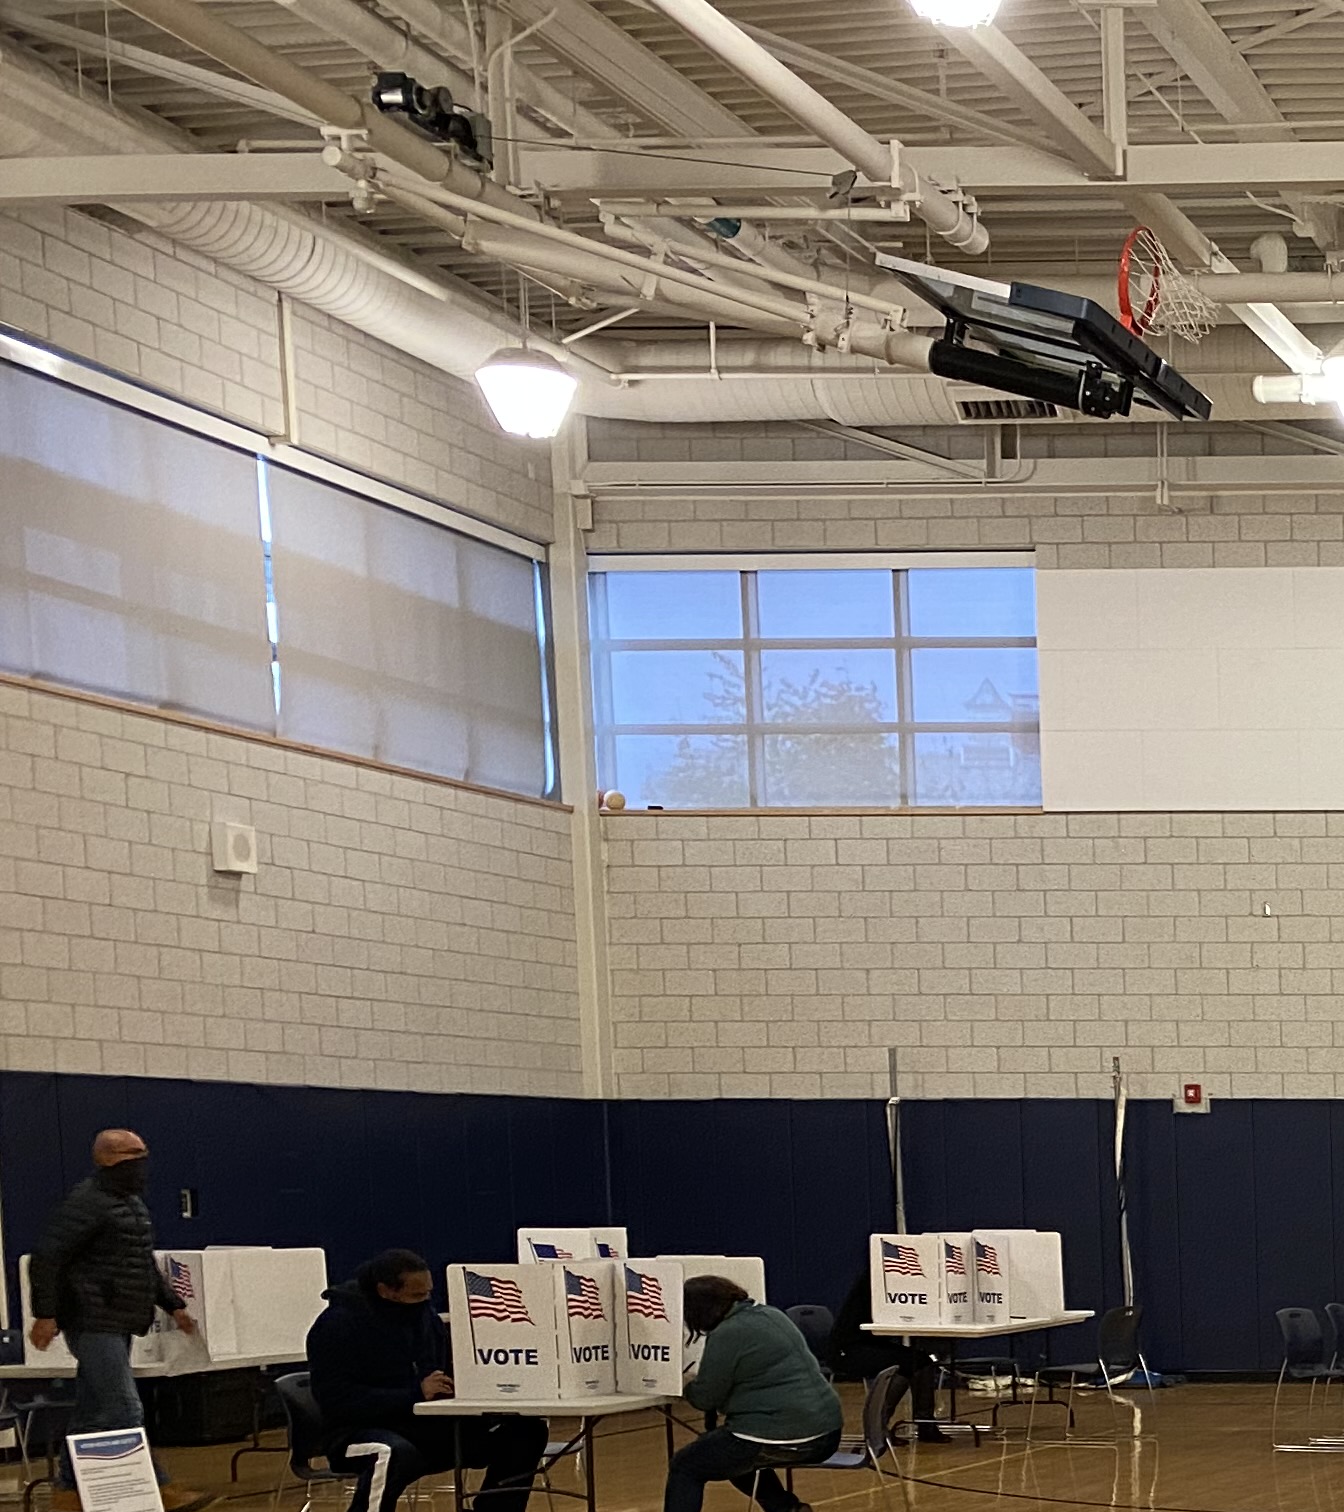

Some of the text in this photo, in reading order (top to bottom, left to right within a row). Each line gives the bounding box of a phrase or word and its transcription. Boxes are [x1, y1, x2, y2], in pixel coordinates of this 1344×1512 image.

[887, 1292, 927, 1305] VOTE
[947, 1291, 967, 1304] VOTE
[979, 1292, 1003, 1304] VOTE
[478, 1348, 539, 1365] VOTE
[573, 1344, 609, 1363] VOTE
[631, 1343, 670, 1361] VOTE
